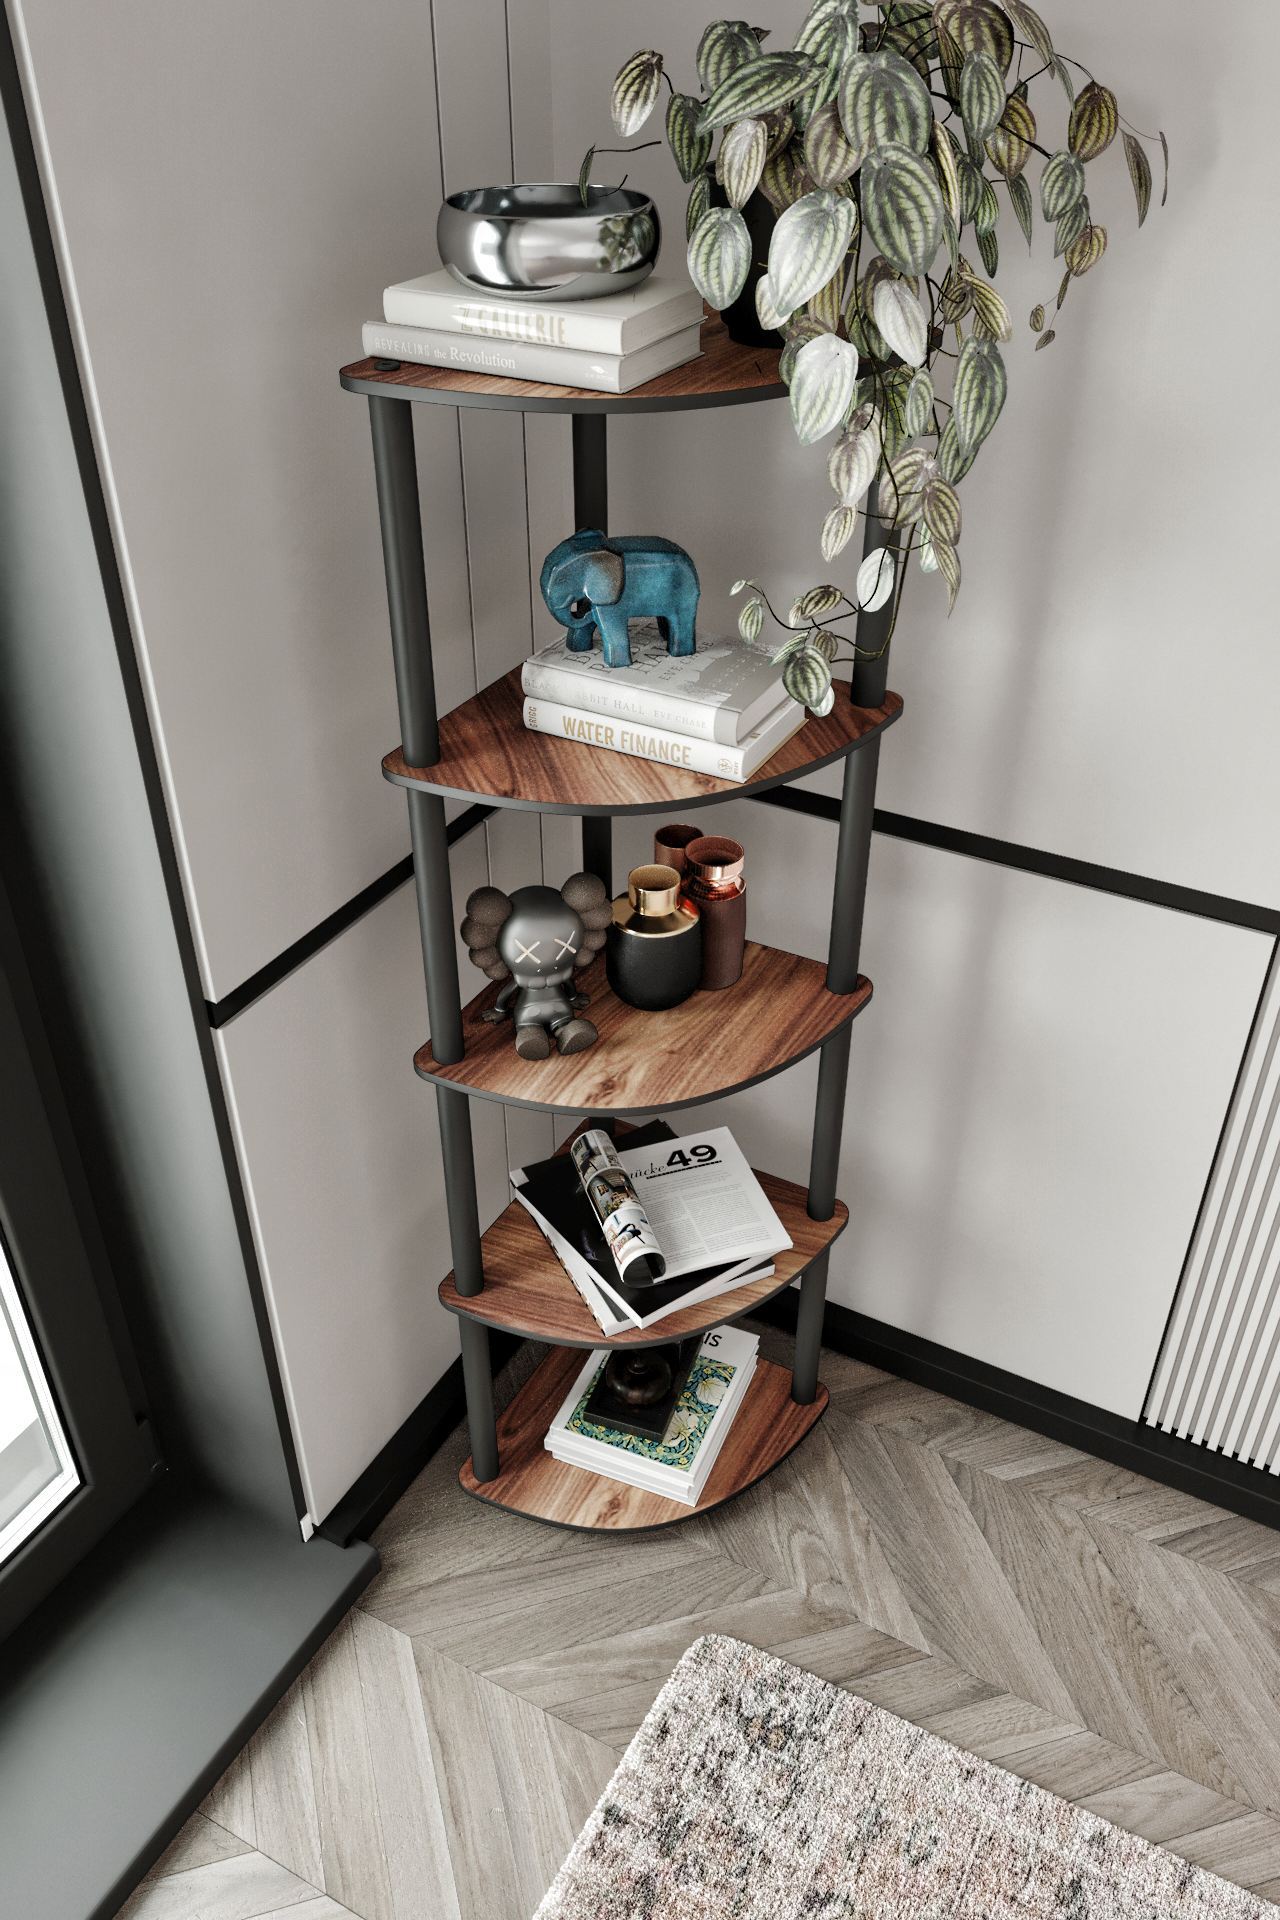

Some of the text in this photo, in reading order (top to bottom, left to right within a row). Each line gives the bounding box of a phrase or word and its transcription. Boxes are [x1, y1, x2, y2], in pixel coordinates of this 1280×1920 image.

[374, 337, 516, 370] REVEALING the Revolution
[562, 715, 692, 766] WATER FINANCE
[666, 1144, 717, 1167] 49
[703, 1332, 723, 1347] IS
